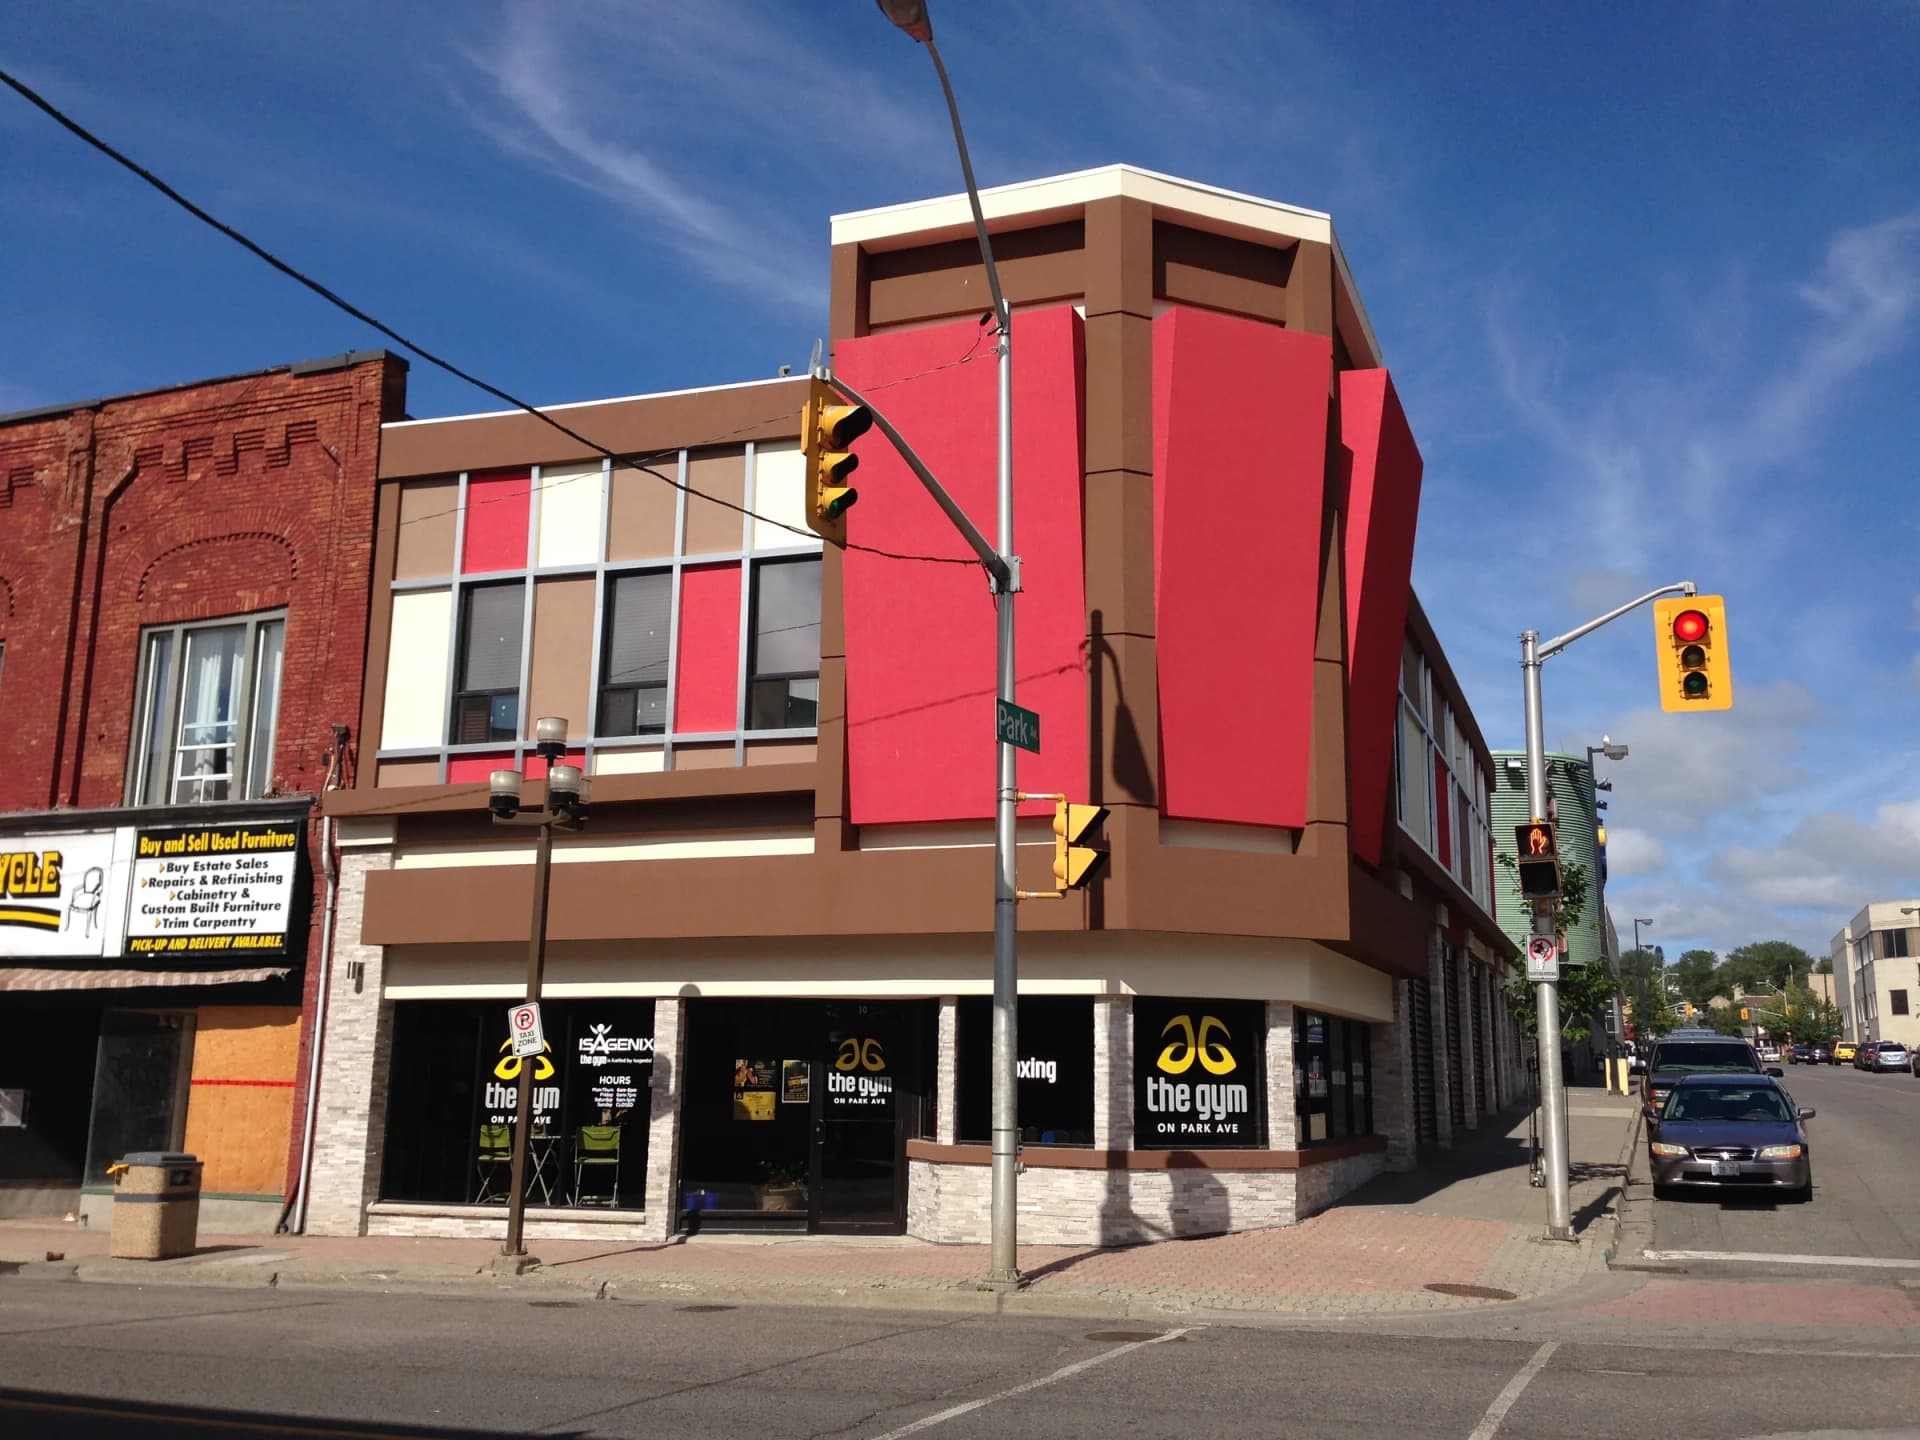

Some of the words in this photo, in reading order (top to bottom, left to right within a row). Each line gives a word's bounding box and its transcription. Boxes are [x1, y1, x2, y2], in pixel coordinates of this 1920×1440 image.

[998, 703, 1028, 745] Park
[140, 837, 162, 857] Buy
[164, 834, 186, 853] and
[187, 832, 209, 851] Sell
[211, 830, 240, 850] Used
[241, 829, 295, 848] Furniture
[166, 862, 189, 873] Buy
[193, 861, 232, 871] Estate
[235, 857, 269, 870] Sales
[149, 876, 195, 889] Repairs
[199, 875, 208, 885] &
[212, 872, 283, 886] Refinishing
[176, 889, 237, 901] Cabinetry
[241, 887, 250, 898] &
[141, 903, 186, 914] Custom
[190, 902, 220, 913] Built
[223, 900, 282, 912] Furniture
[162, 917, 189, 929] Trim
[193, 916, 257, 929] Carpentry
[131, 938, 167, 951] PICK-UP
[168, 937, 187, 950] AND
[188, 935, 232, 949] DELIVERY
[232, 935, 283, 949] AVAILABLE.
[518, 1037, 537, 1047] ZONE
[520, 1030, 534, 1039] TAXI
[579, 1032, 655, 1055] ISAGENIX
[1016, 1057, 1057, 1083] xing
[599, 1076, 631, 1085] HOURS
[828, 1072, 856, 1093] the
[858, 1076, 893, 1097] gym
[485, 1082, 517, 1109] the
[532, 1087, 560, 1115] ym
[871, 1097, 886, 1105] AVE
[1147, 1076, 1191, 1112] the
[1195, 1083, 1248, 1121] gym
[491, 1115, 505, 1124] ON
[533, 1115, 551, 1124] AVE
[1157, 1122, 1176, 1133] ON
[1180, 1123, 1212, 1133] PARK
[1216, 1123, 1239, 1133] AVE
